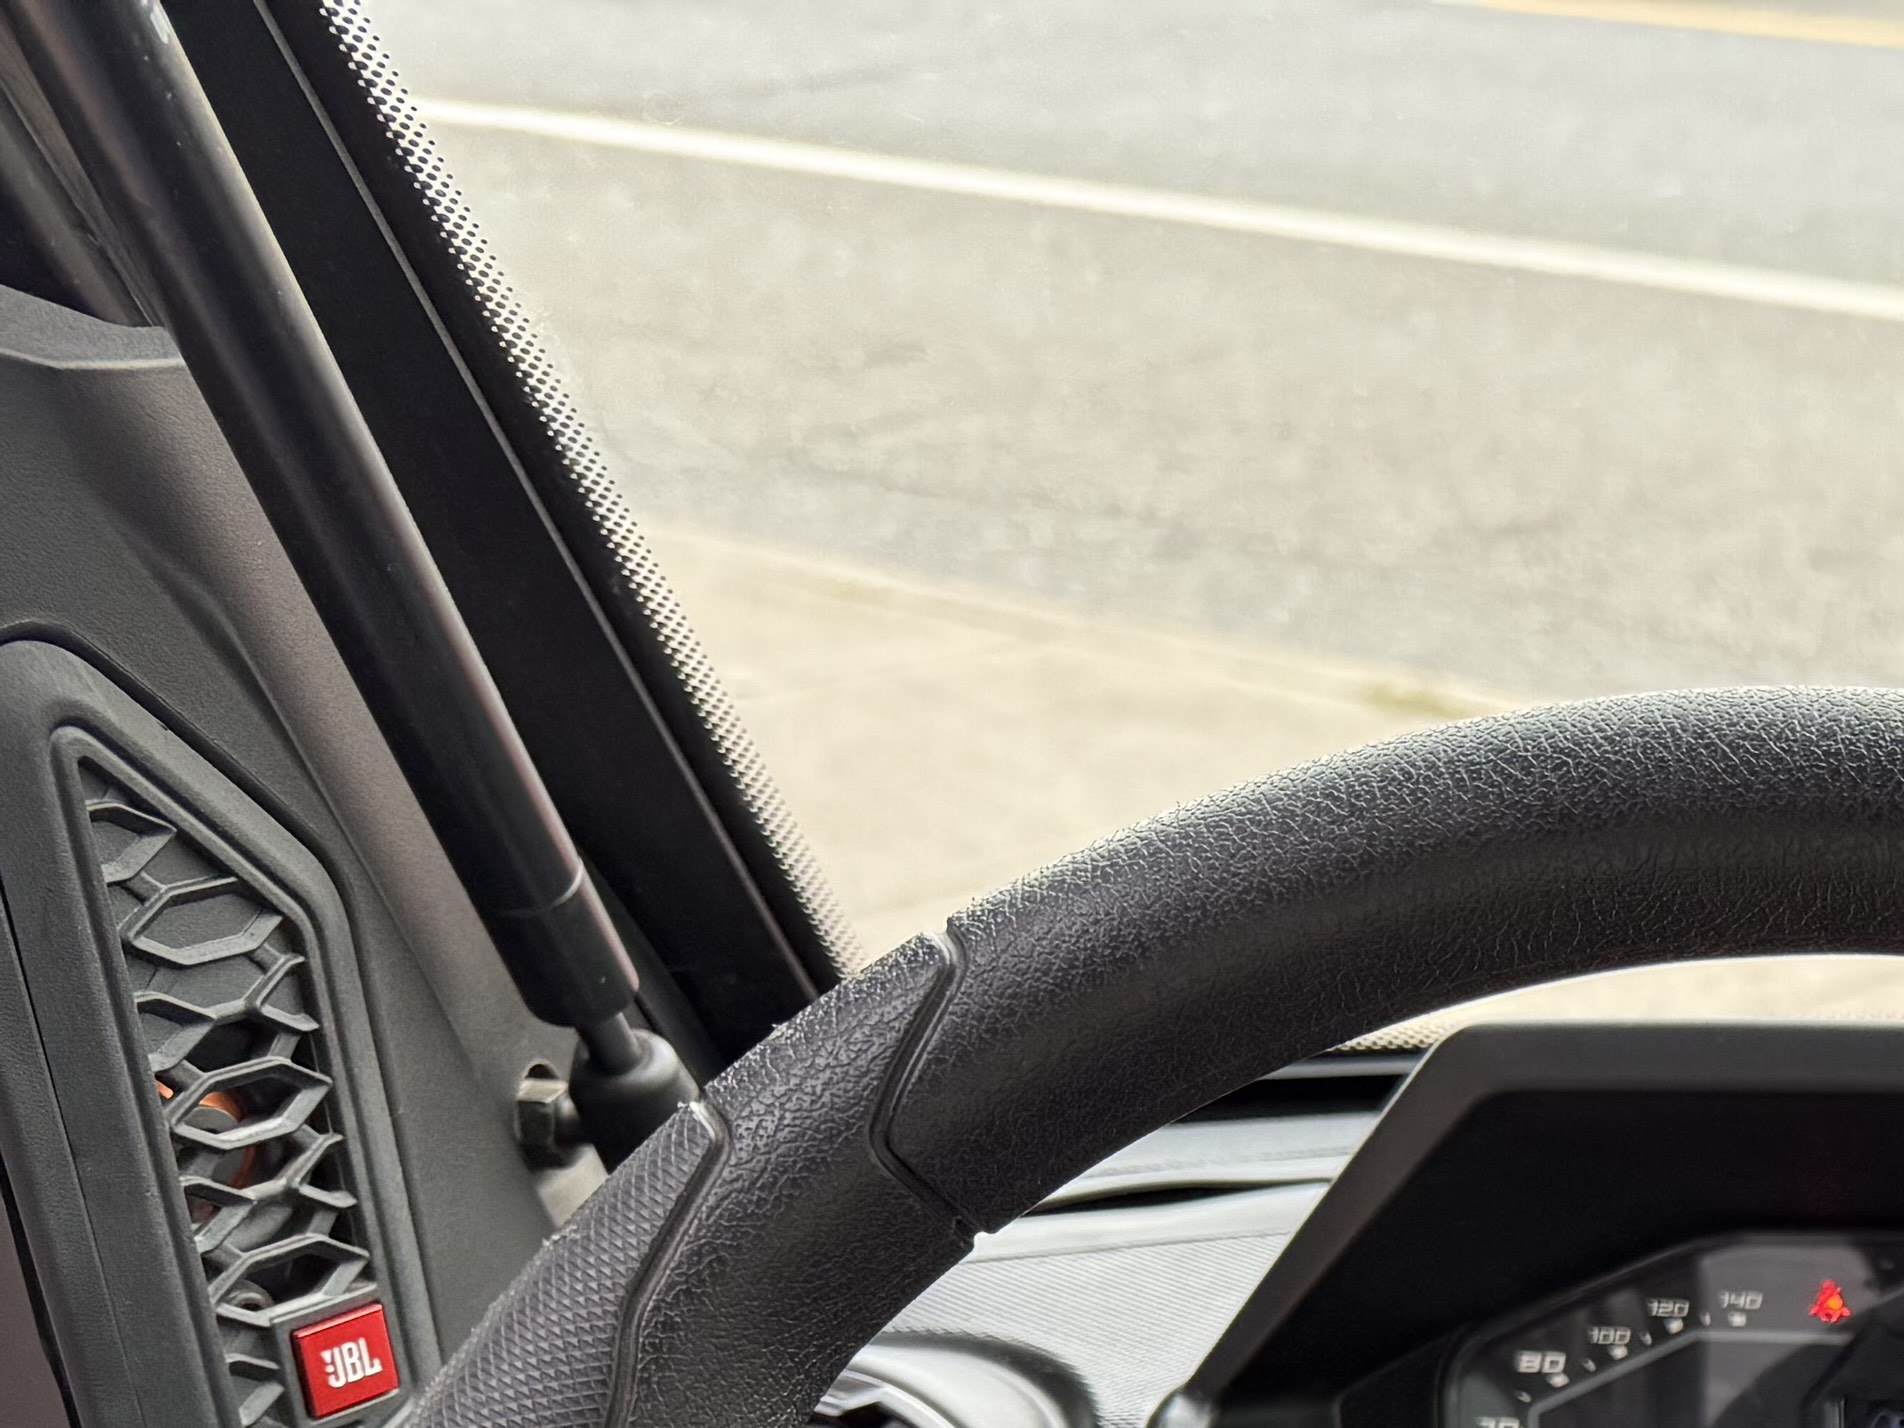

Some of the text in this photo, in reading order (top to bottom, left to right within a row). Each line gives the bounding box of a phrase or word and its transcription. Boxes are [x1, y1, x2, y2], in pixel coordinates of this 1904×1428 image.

[1650, 1299, 1690, 1318] 120
[1720, 1291, 1763, 1310] 140
[1589, 1326, 1631, 1345] 100
[320, 1337, 383, 1388] JBL
[1516, 1352, 1566, 1373] 80
